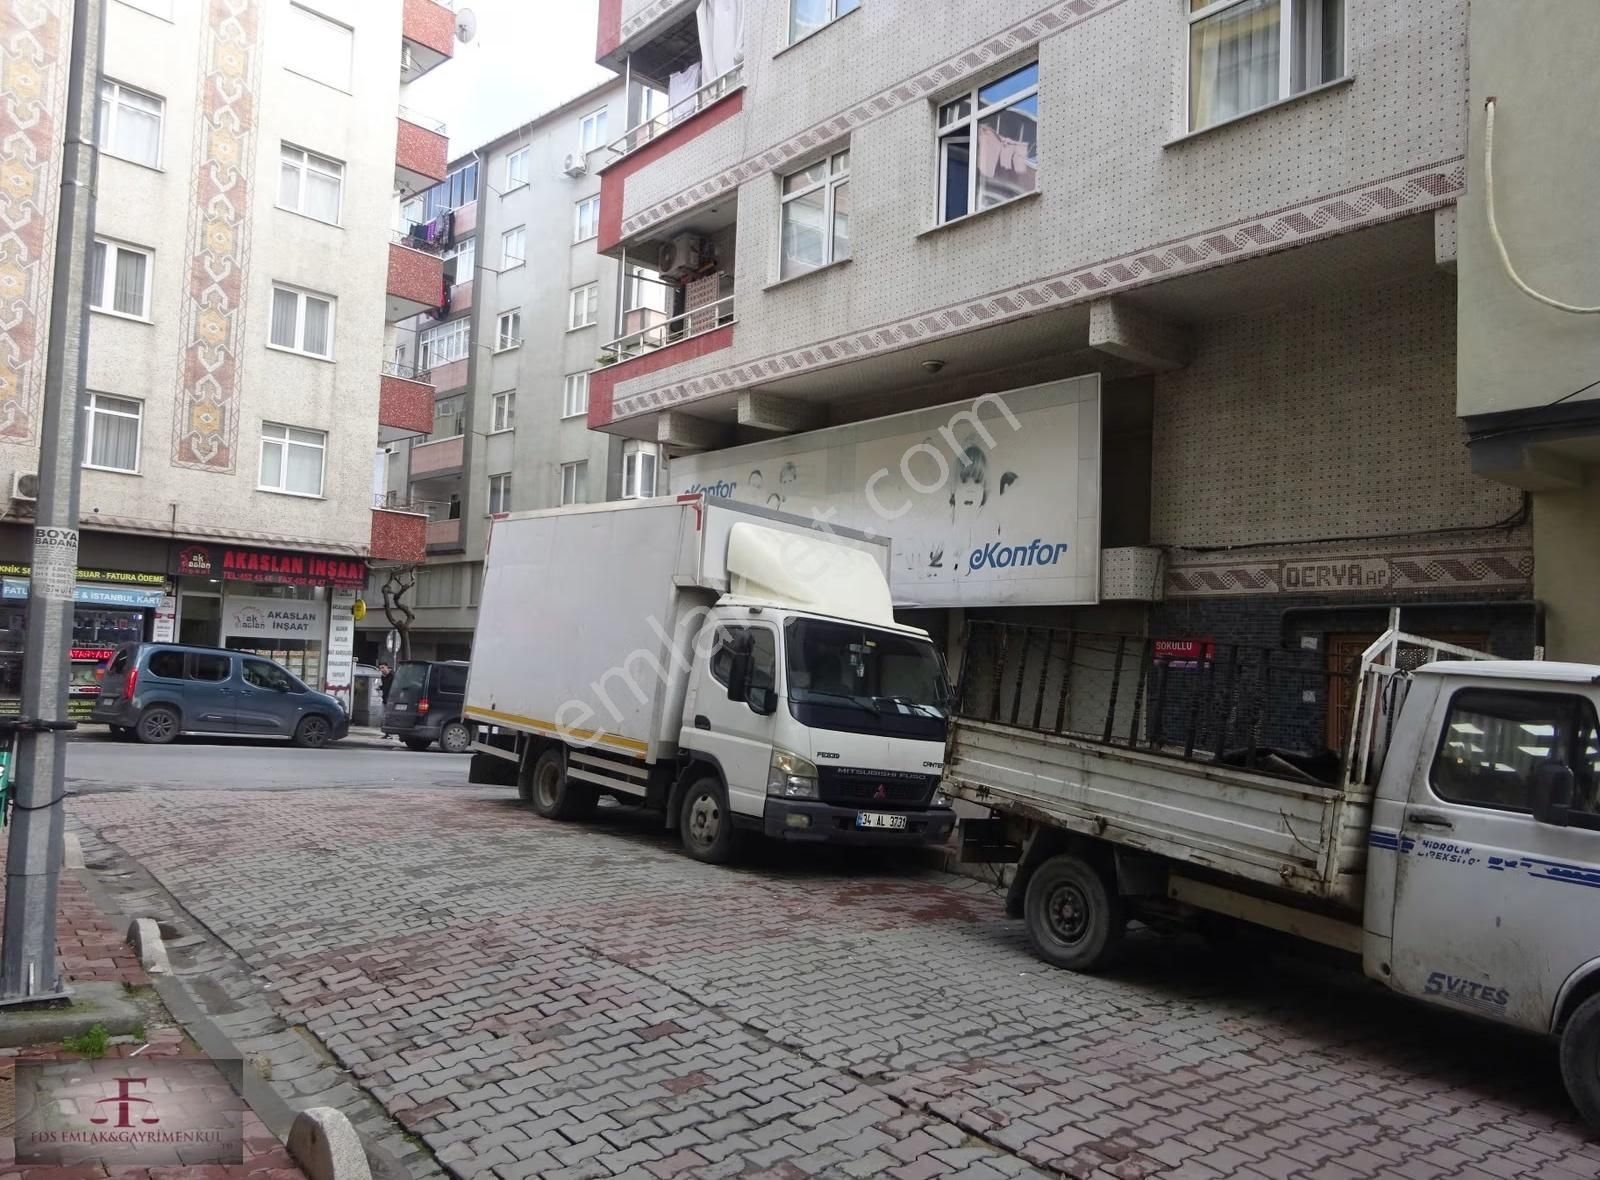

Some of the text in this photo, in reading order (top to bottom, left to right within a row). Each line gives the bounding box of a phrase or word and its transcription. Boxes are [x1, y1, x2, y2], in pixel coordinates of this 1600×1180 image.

[36, 529, 78, 541] BOYA
[34, 538, 77, 548] BADANA
[223, 551, 365, 580] AKASLAN İNŞAAT
[107, 573, 136, 581] FATURA
[138, 574, 164, 583] ÖDEME
[1286, 564, 1362, 588] DERYA
[90, 591, 134, 603] İSTANBUL
[267, 611, 317, 621] AKASLAN
[272, 620, 309, 631] İNŞAAT
[1155, 641, 1193, 651] SOKULLU
[837, 768, 897, 777] MITSUBISHI
[863, 814, 871, 825] 34
[876, 815, 886, 826] AL
